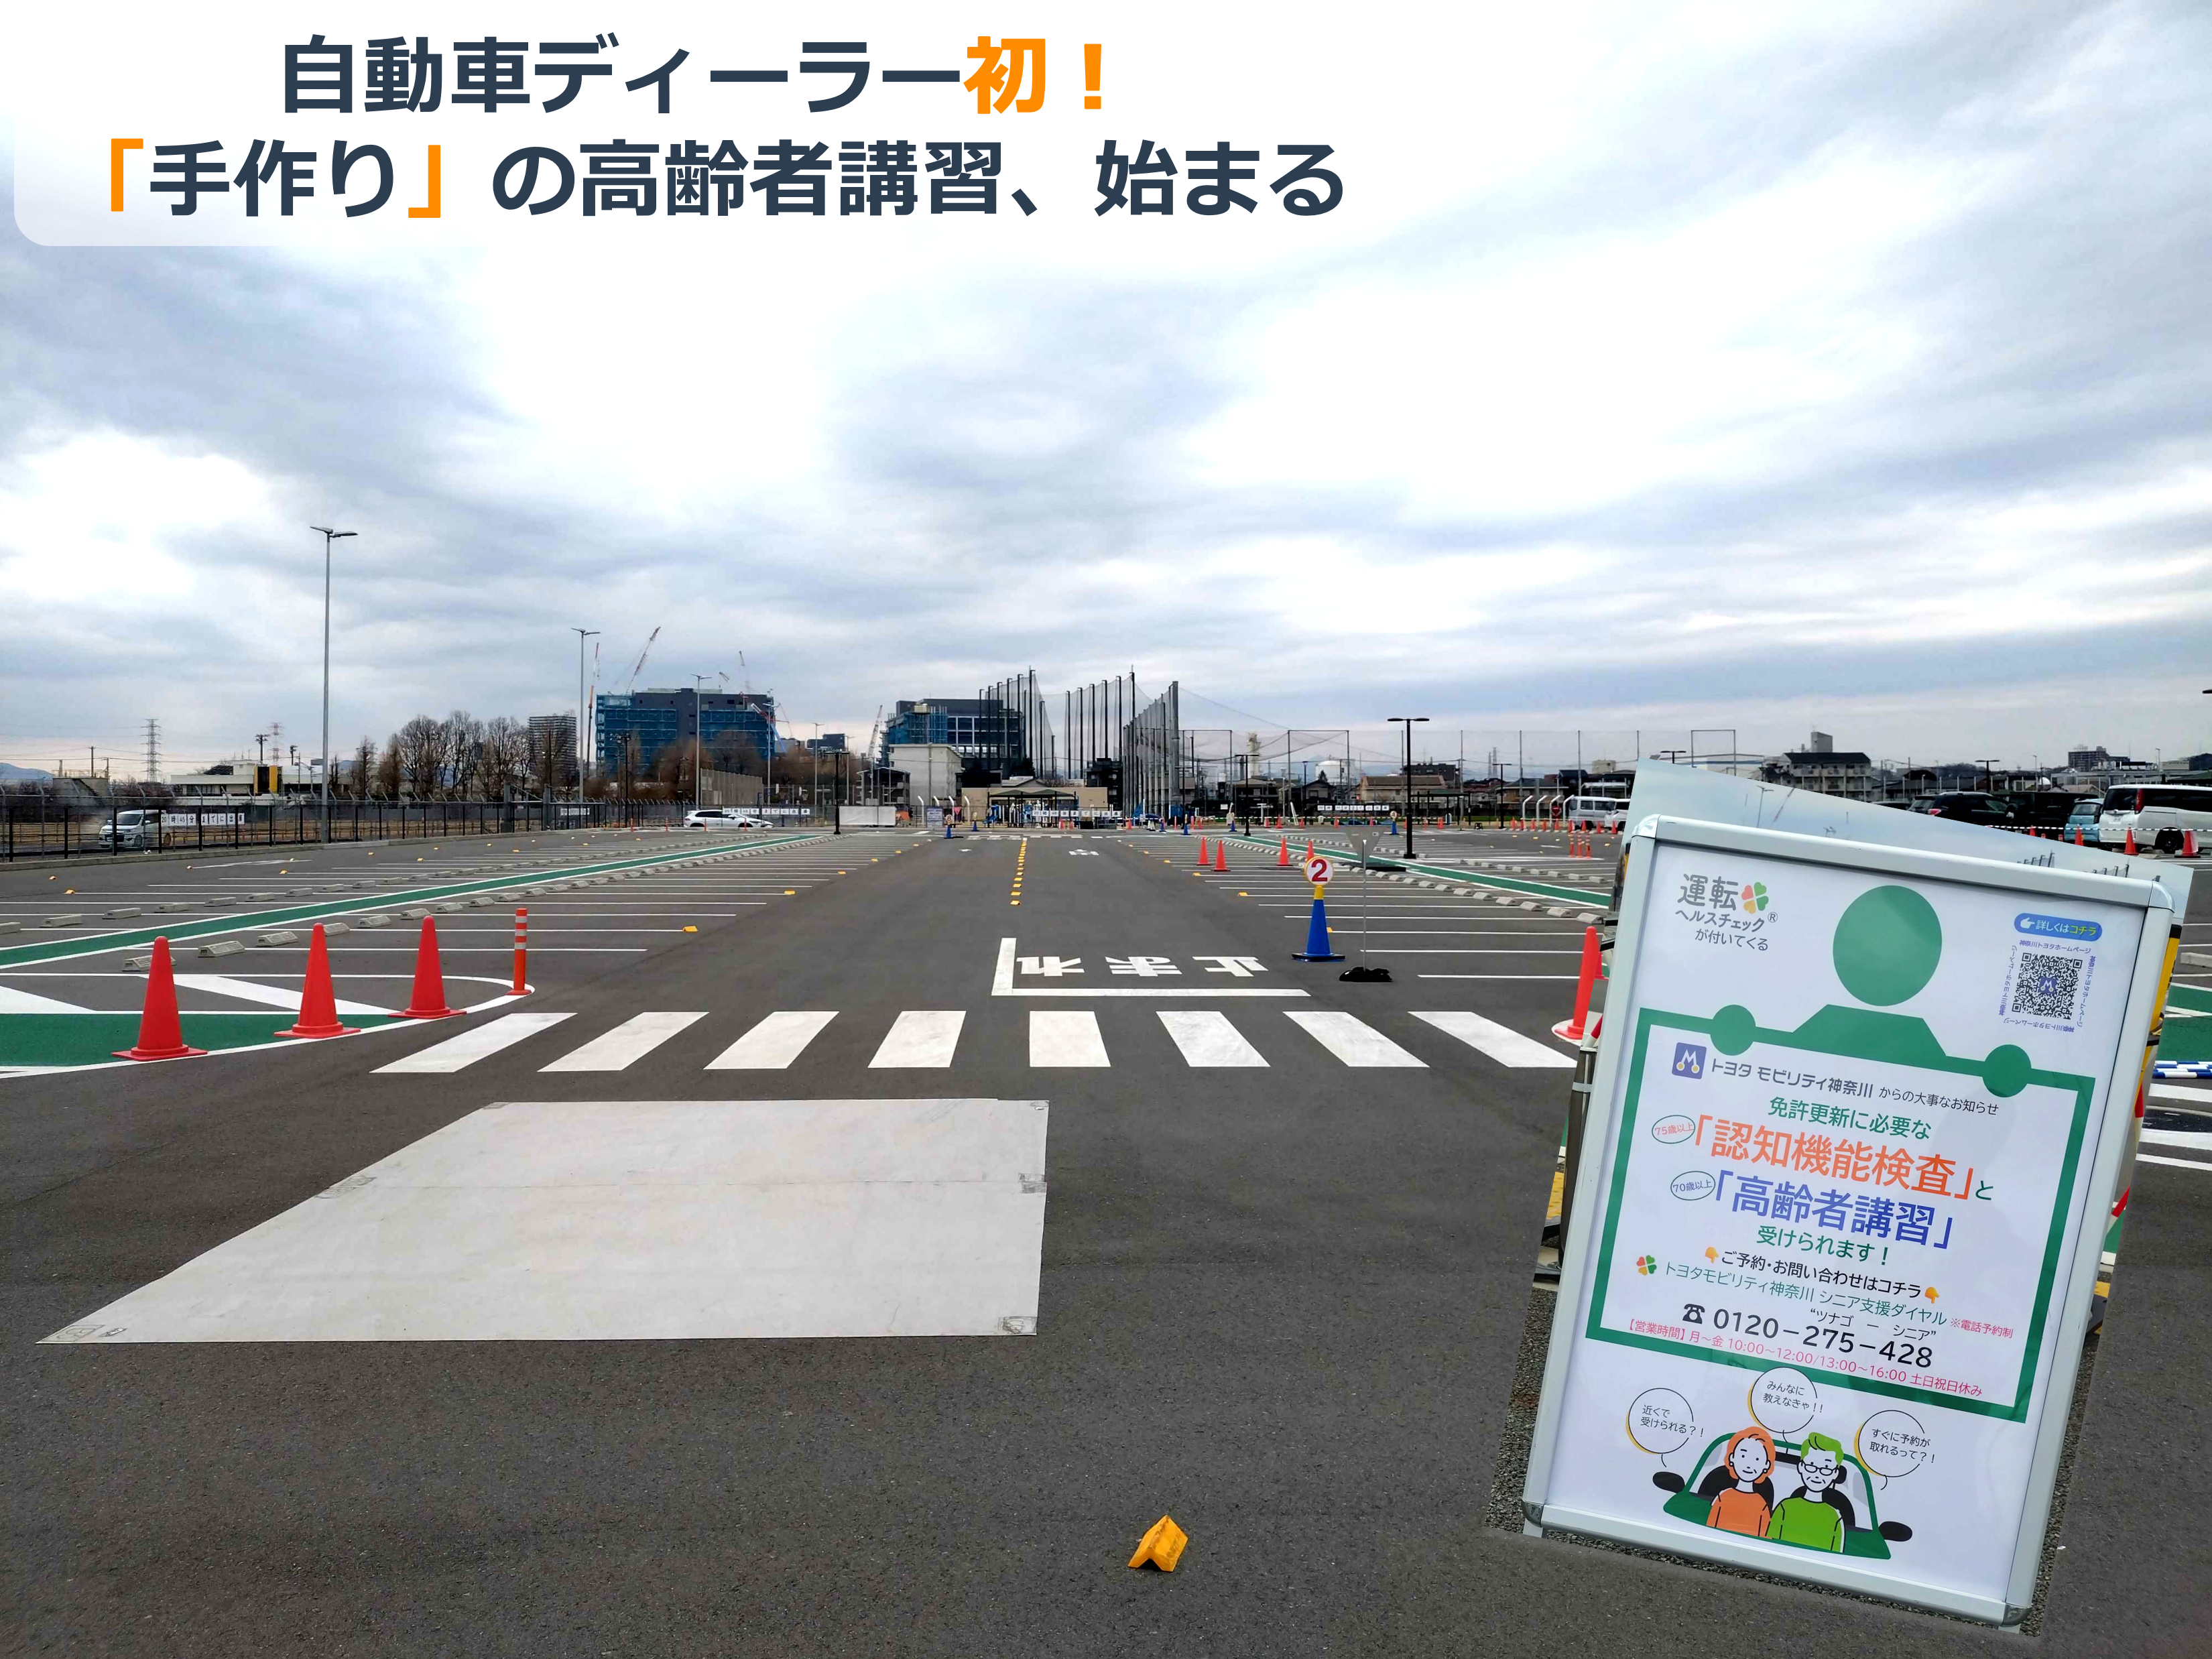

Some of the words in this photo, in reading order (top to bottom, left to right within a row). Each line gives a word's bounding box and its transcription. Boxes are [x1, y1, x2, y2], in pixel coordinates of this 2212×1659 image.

[1311, 859, 1327, 881] 2
[1677, 873, 1739, 911] 運転
[1695, 928, 1768, 951] が付いてくる
[2036, 920, 2097, 936] 詳しくはコチラ
[2020, 940, 2091, 954] 神奈川トヨタホームページ
[1712, 1059, 1752, 1078] トヨタ
[1757, 1066, 1873, 1099] モビリティ神奈川
[1879, 1087, 2000, 1116] からの大事なお知らせ
[1654, 1122, 1695, 1135] 75歳以上
[1768, 1096, 1932, 1140] 免許更新に必要な
[1695, 1114, 1994, 1201] 「認知機能検査」と
[1672, 1179, 1713, 1192] 70歳以上
[1715, 1170, 1953, 1249] 「高齢者講習」
[1756, 1225, 1890, 1266] 受けられます！
[1721, 1250, 1922, 1298] ご予約・お問い合わせはコチラ
[1665, 1262, 1814, 1302] トヨタモビリティ神奈川
[1819, 1290, 1947, 1326] シニア支援ダイヤル
[1713, 1308, 1934, 1369] 0120-275-428
[1950, 1318, 2014, 1339] ※電話予約制
[1767, 1381, 1805, 1396] みんなに
[1910, 1373, 1983, 1398] 土日祝日休み
[1642, 1405, 1671, 1419] 近くで
[1871, 1428, 1931, 1449] すぐに予約が
